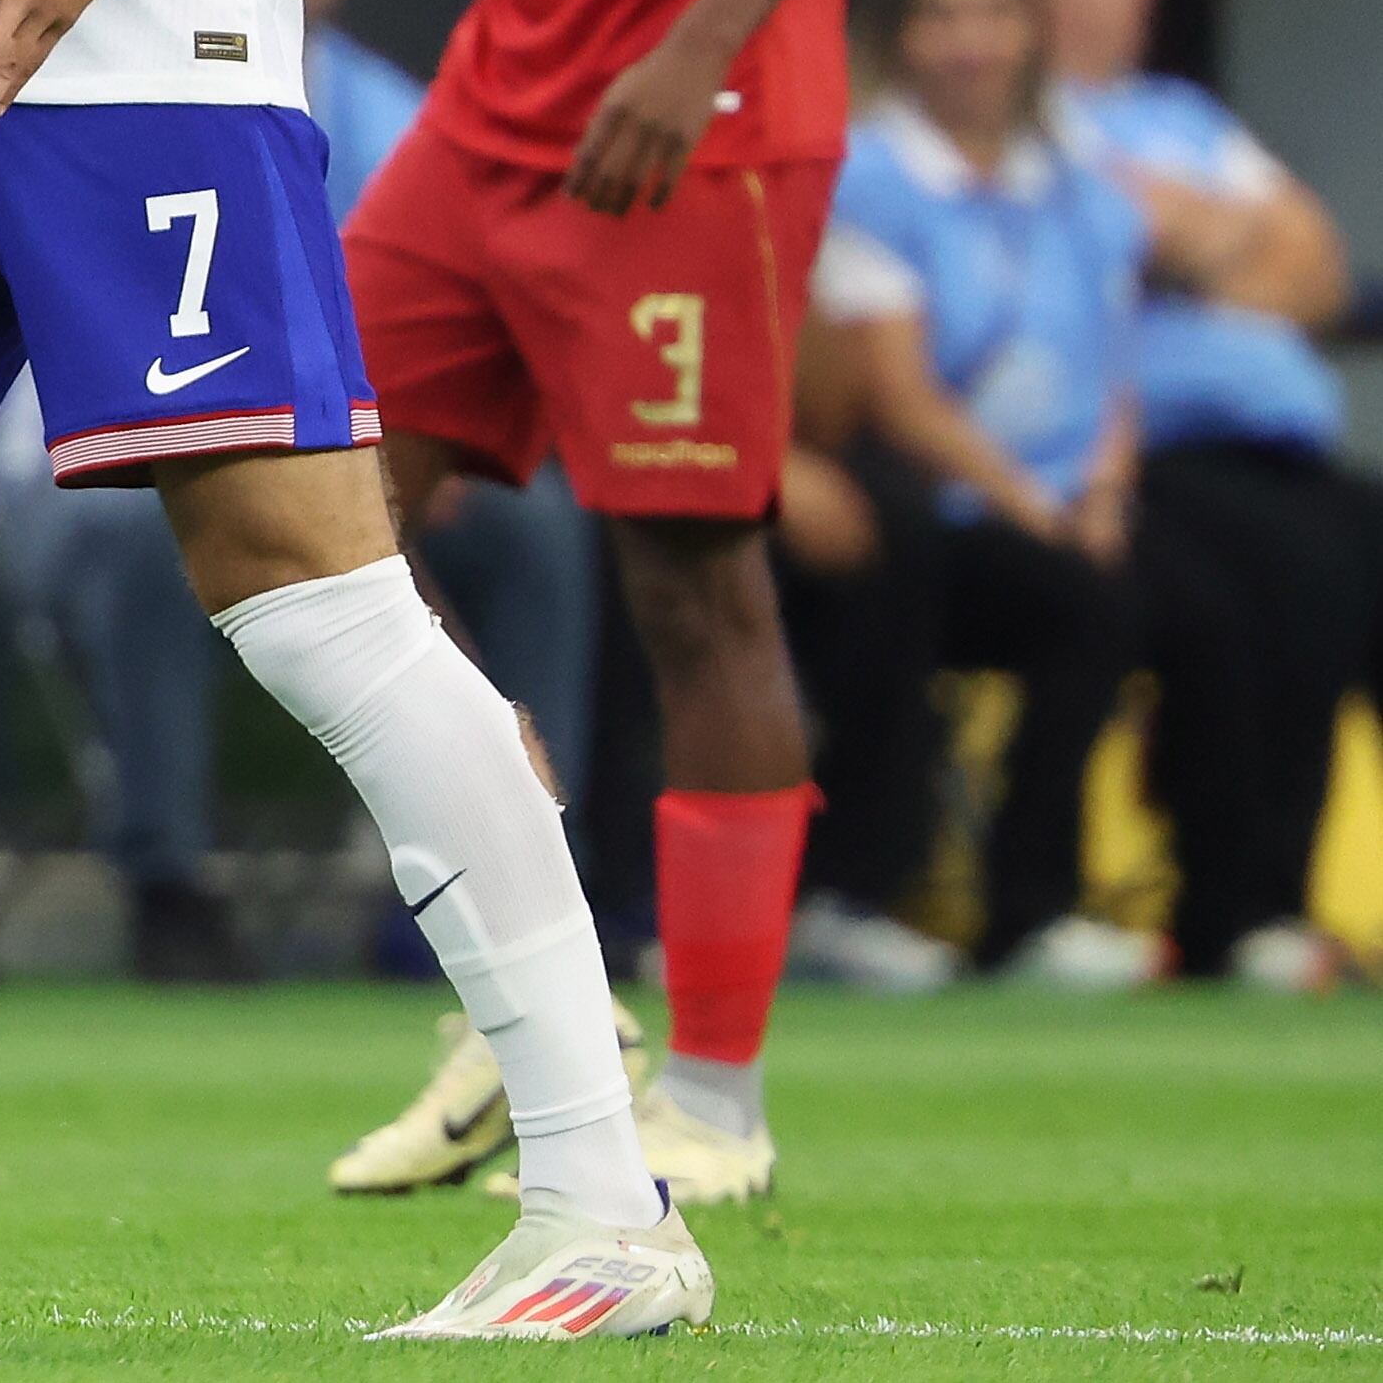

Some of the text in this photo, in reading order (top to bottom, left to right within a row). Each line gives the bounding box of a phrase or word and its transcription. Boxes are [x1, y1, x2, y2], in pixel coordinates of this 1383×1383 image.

[145, 189, 219, 337] 7
[630, 292, 704, 429] 3
[560, 1256, 657, 1283] F50
